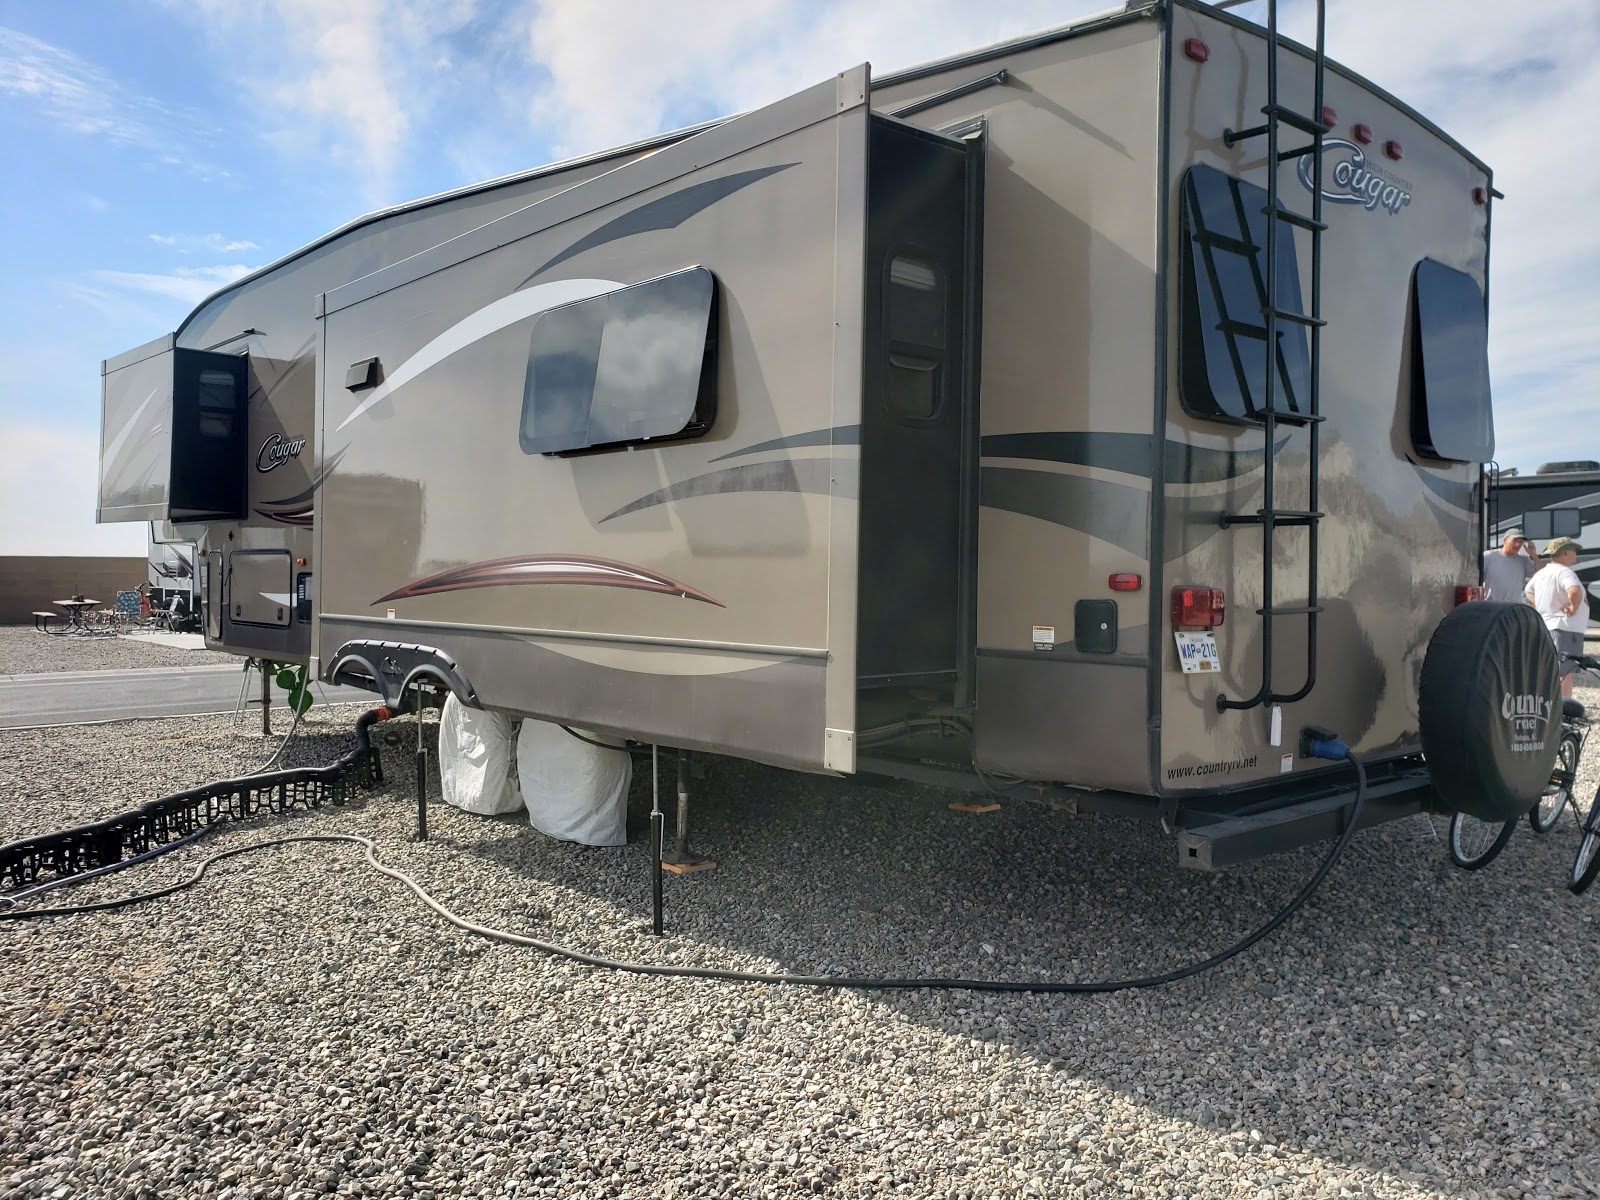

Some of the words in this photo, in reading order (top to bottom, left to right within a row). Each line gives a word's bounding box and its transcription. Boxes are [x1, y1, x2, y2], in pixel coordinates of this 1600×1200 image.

[1297, 138, 1411, 216] Cougar
[256, 432, 306, 473] Cougar
[1167, 755, 1258, 780] www.countryrv.net
